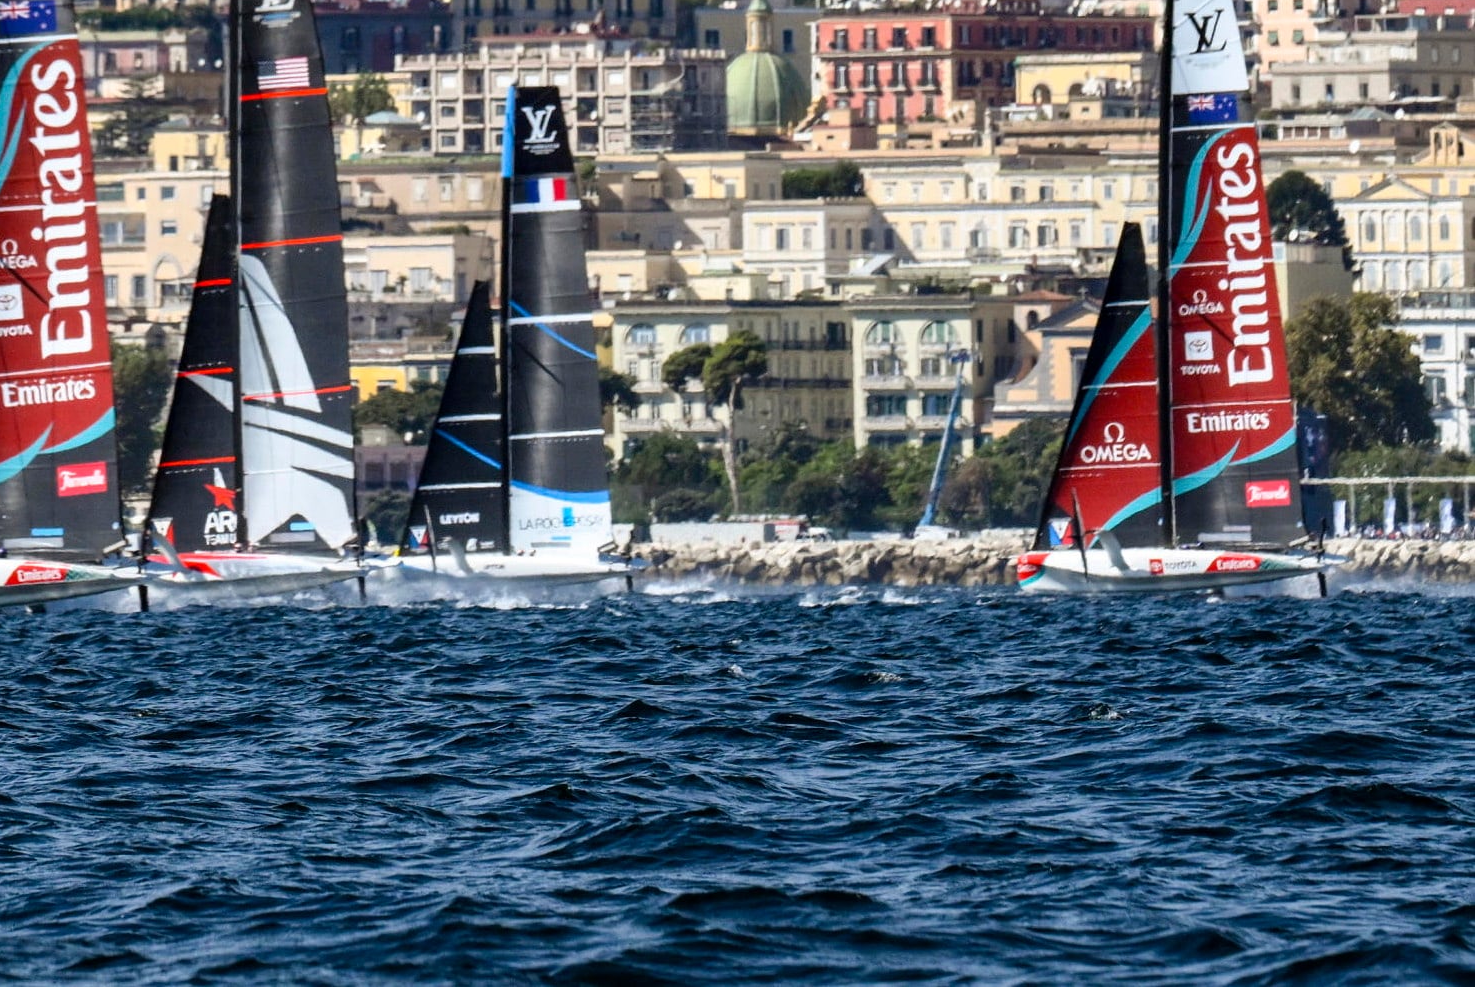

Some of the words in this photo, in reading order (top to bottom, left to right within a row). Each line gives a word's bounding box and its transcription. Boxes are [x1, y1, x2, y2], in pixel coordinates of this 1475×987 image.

[28, 58, 94, 359] Emirates
[1215, 142, 1274, 388] Emirates
[1180, 363, 1222, 376] TOYOTA
[0, 379, 97, 408] Emirates
[1186, 412, 1270, 433] Emirates
[1080, 443, 1152, 463] OMEGA
[17, 568, 62, 582] Emirates
